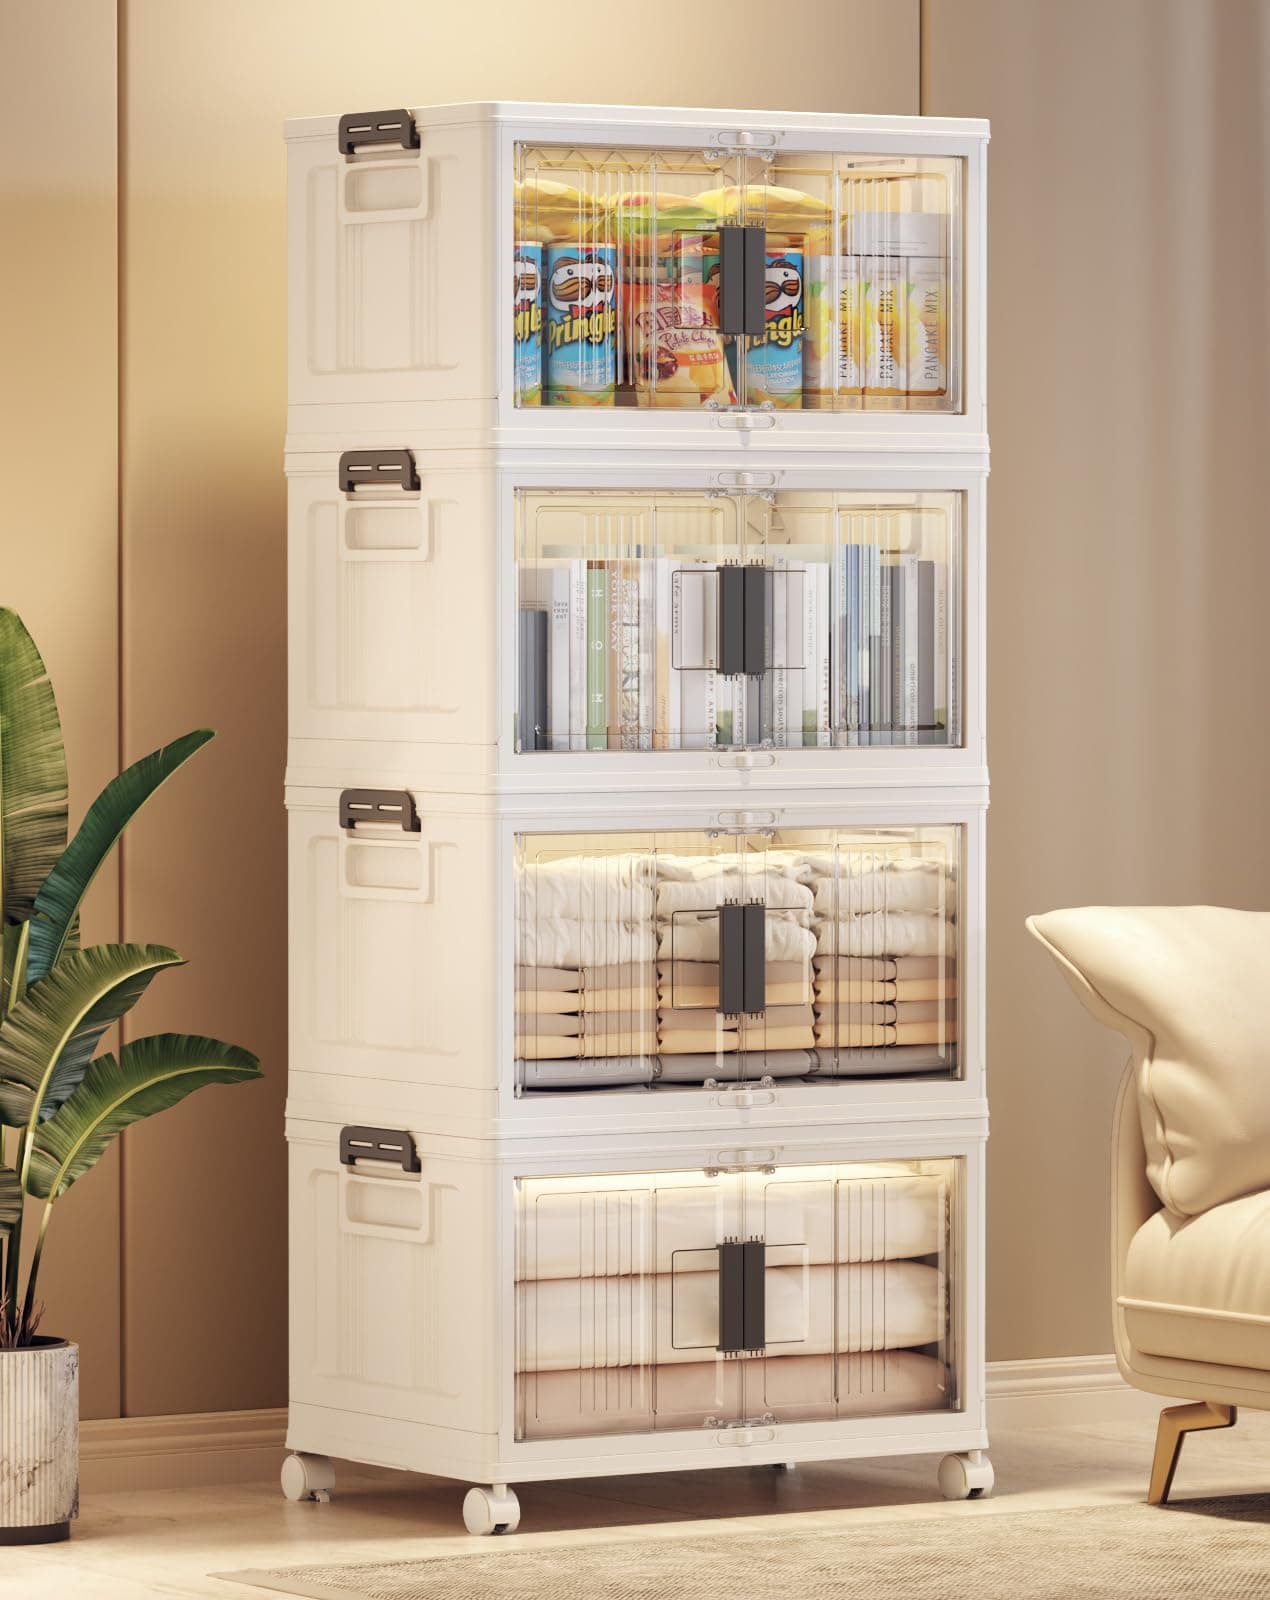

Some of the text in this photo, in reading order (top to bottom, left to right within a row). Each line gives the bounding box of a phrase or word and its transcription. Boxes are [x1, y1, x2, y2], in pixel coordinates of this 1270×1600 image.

[840, 289, 849, 312] MIX
[880, 289, 893, 313] MIX
[925, 289, 938, 314] MIX
[924, 320, 938, 379] PANCAKE
[611, 620, 619, 652] WAY
